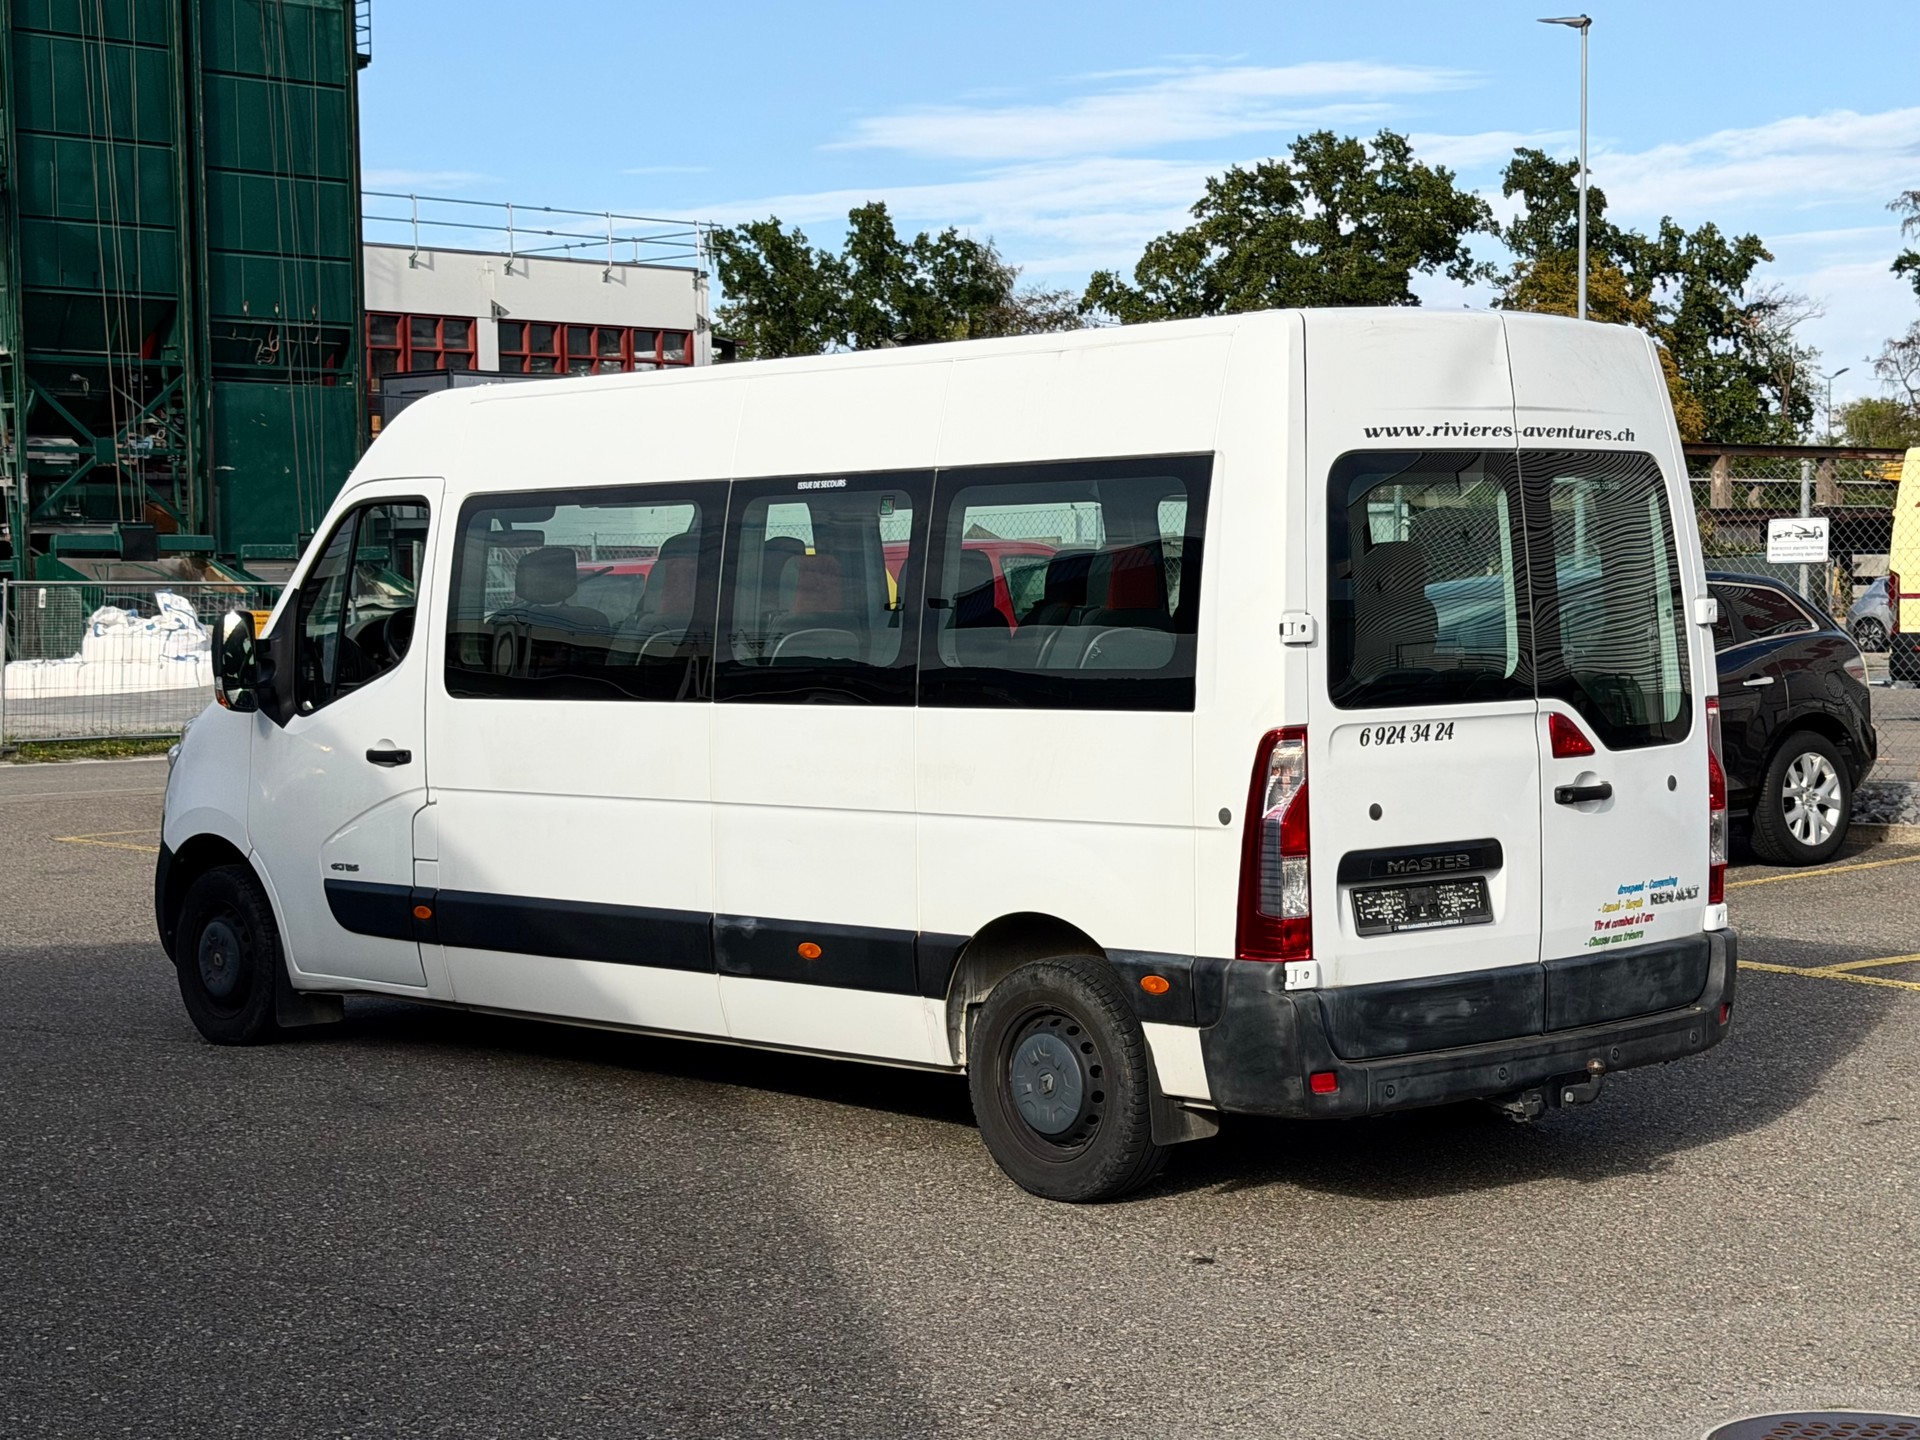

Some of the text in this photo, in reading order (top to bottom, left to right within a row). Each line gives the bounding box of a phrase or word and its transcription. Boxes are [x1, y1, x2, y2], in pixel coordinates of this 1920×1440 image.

[1363, 422, 1636, 443] www.rivieres-aventures.ch
[797, 481, 813, 490] ISSUE
[813, 480, 821, 489] DE
[1359, 721, 1455, 747] 6 924 34 24
[1387, 854, 1470, 874] MASTER
[1650, 887, 1699, 906] RENAULT
